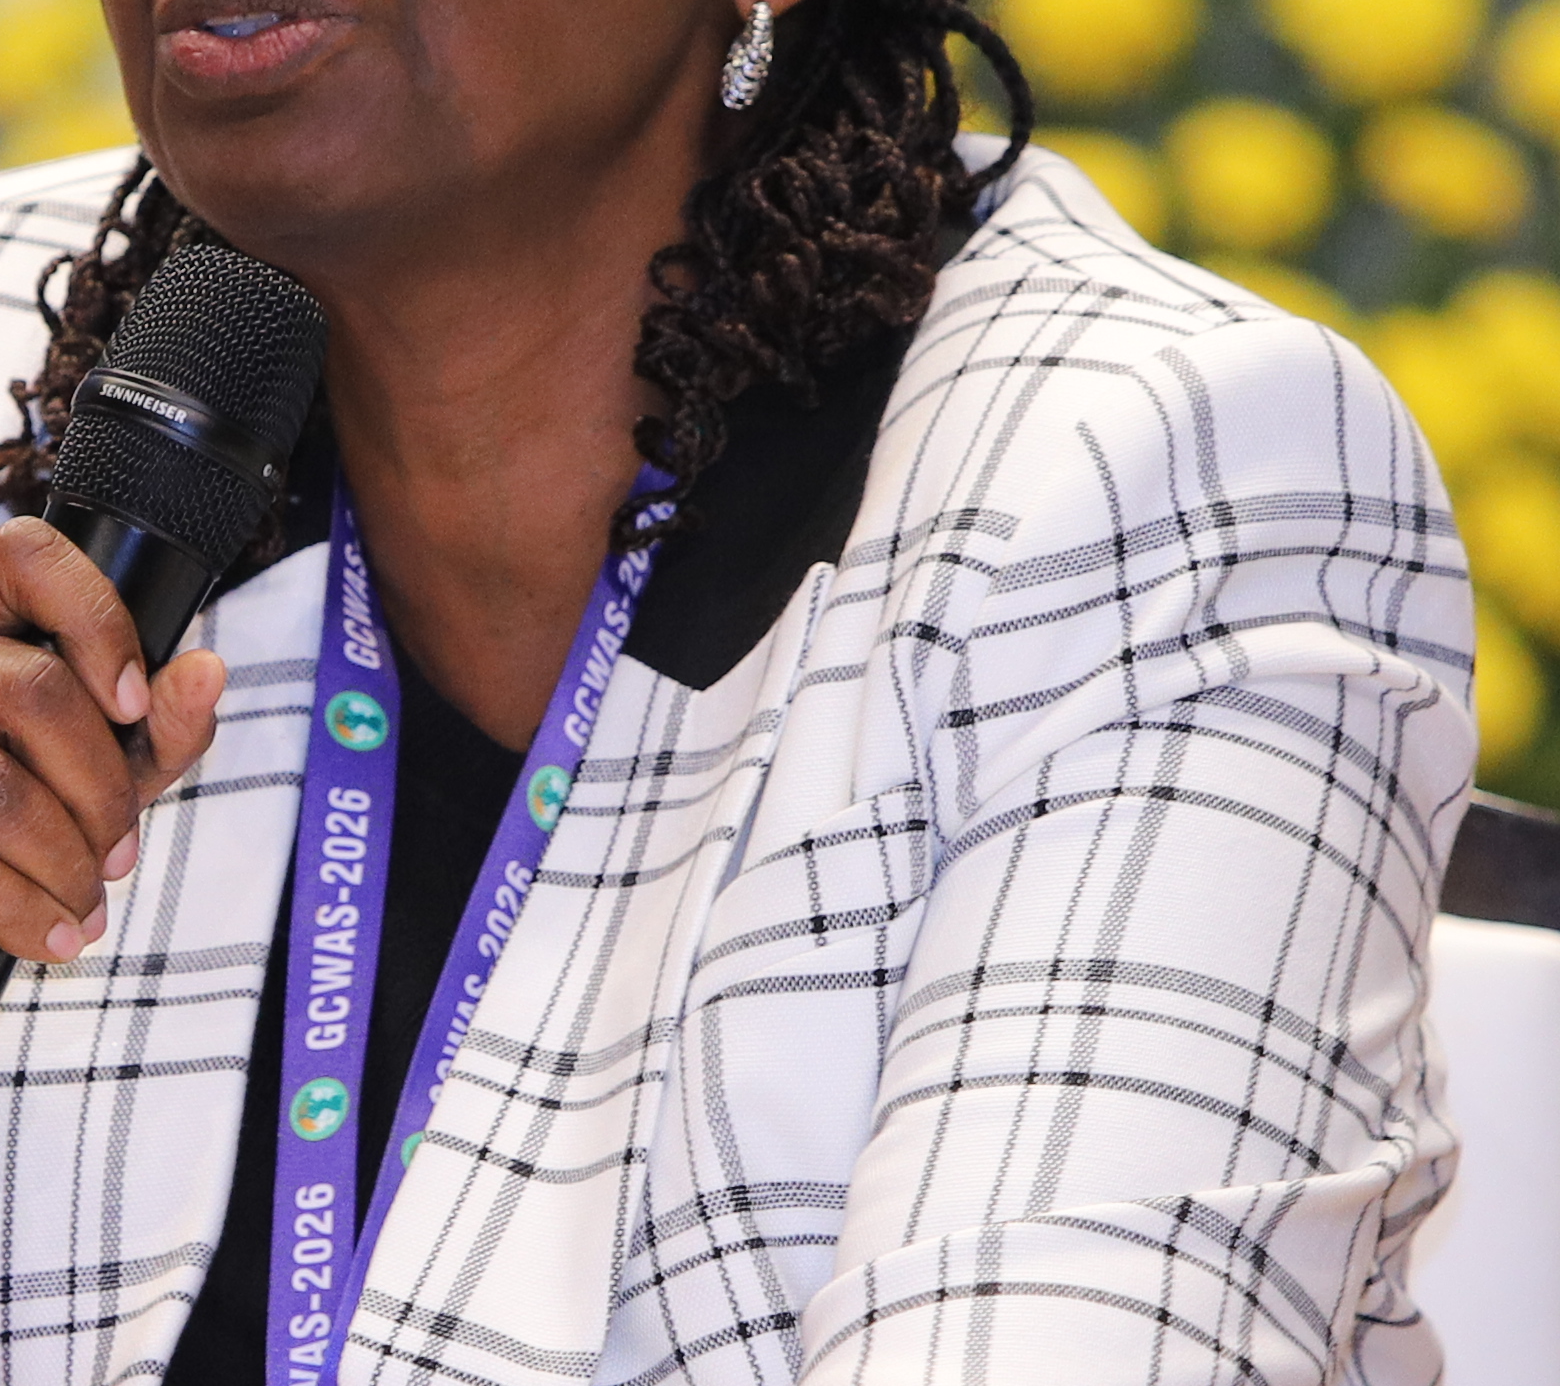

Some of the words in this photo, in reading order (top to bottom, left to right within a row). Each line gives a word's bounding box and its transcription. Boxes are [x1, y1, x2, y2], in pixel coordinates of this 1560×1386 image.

[99, 383, 188, 424] SENNHEISER
[342, 509, 382, 671] GCWAS-
[304, 786, 372, 1051] GCWAS-2026
[427, 859, 532, 1105] WAS-2026
